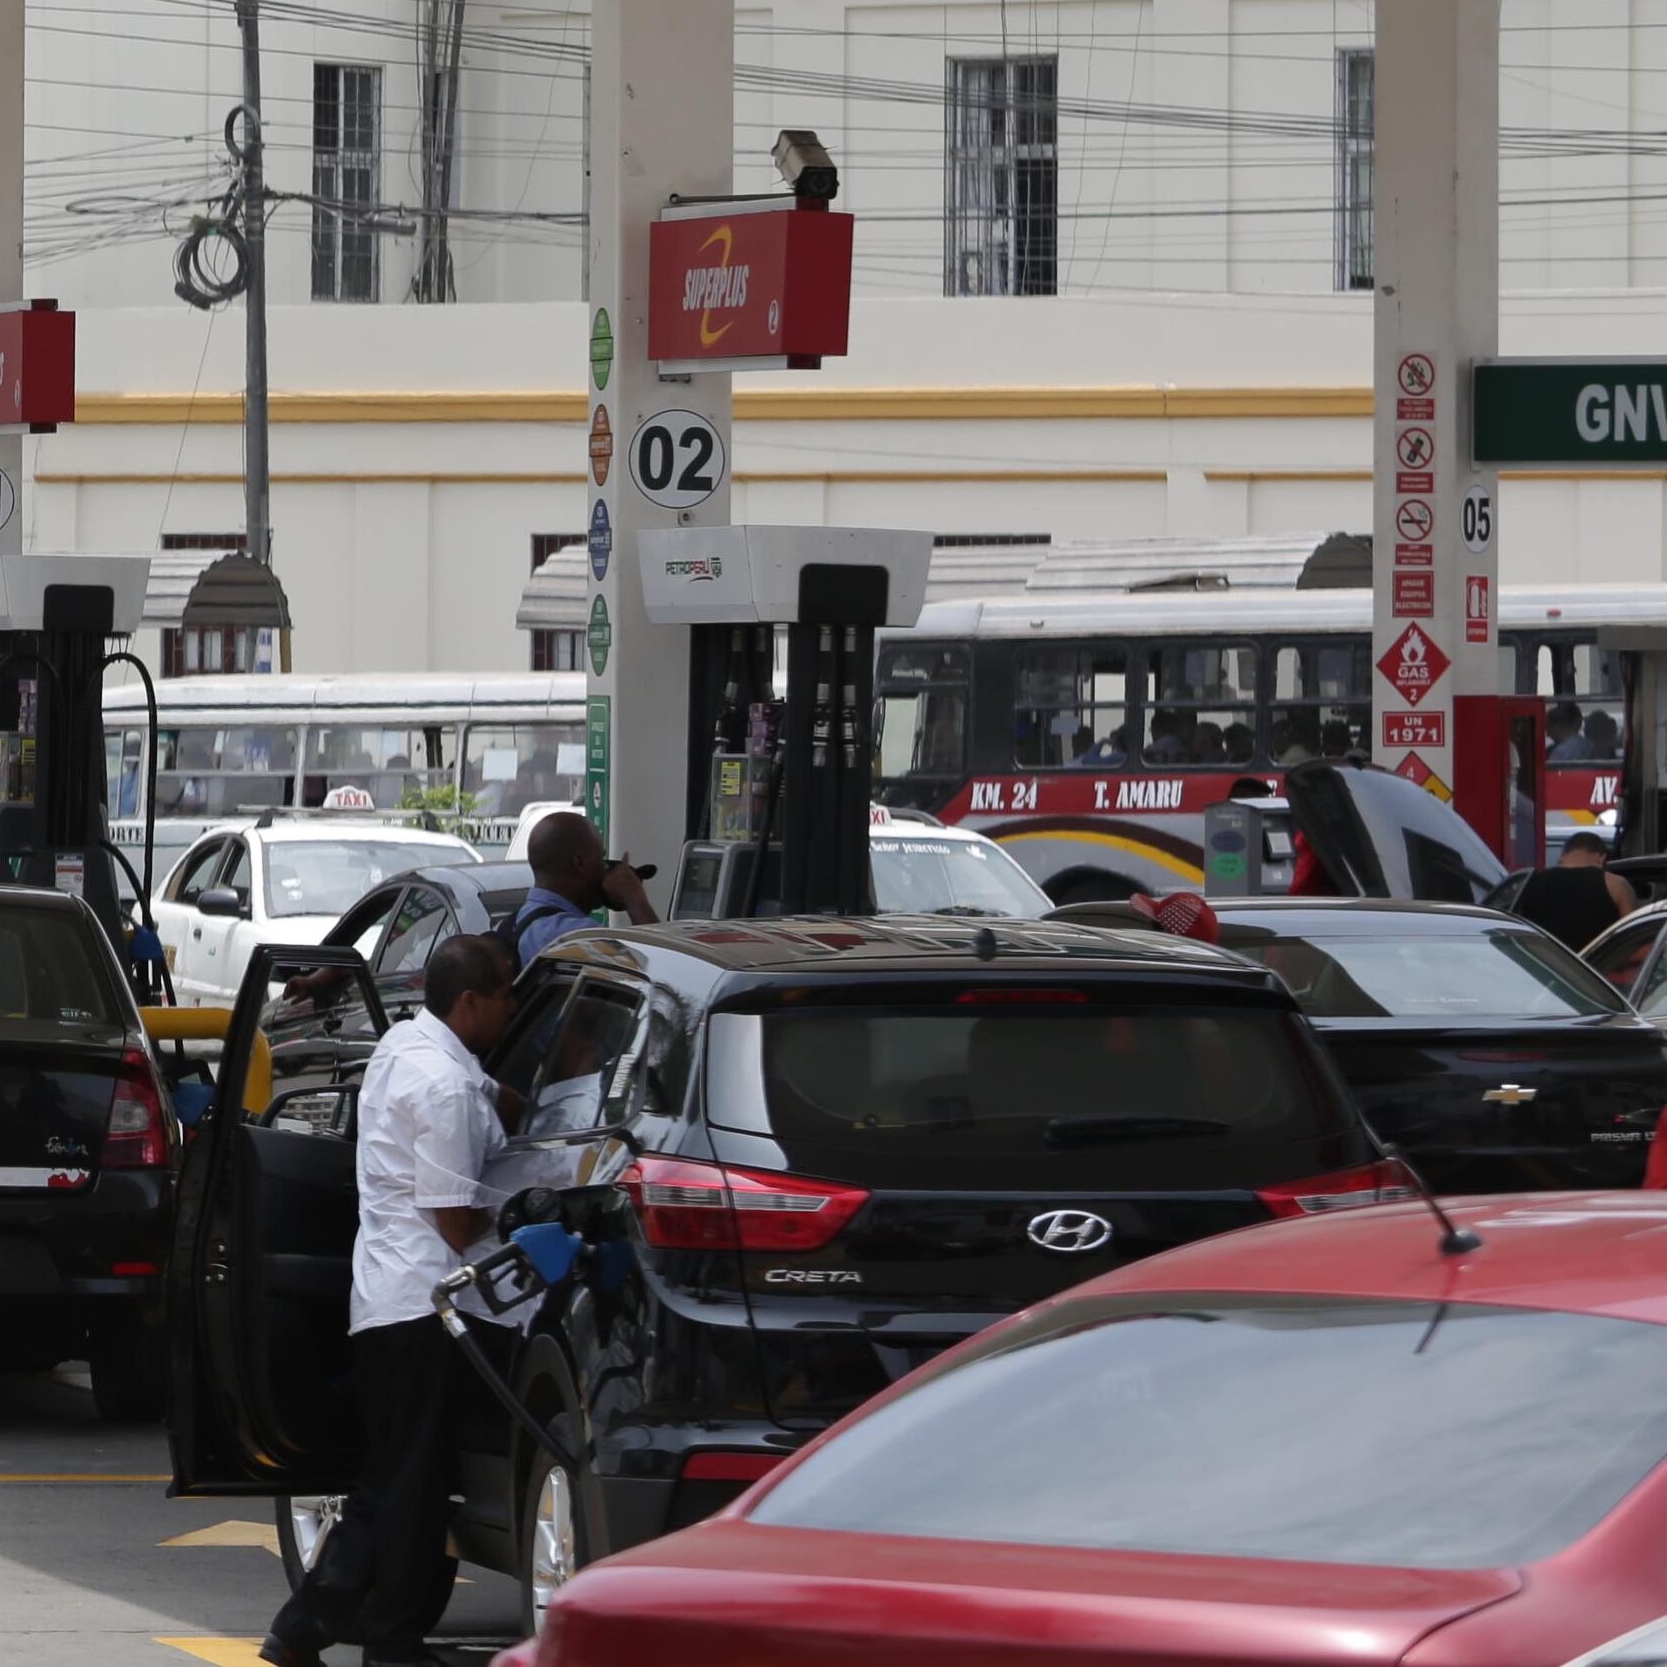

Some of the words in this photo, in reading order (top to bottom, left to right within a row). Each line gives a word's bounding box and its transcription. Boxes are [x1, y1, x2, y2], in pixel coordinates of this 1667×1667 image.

[682, 264, 750, 311] SUPERPLUS
[638, 425, 714, 493] 02
[1463, 497, 1491, 542] 05
[1398, 666, 1429, 679] GAS
[1410, 689, 1417, 700] 2
[1404, 716, 1422, 726] UN
[1389, 728, 1439, 742] 1971
[1406, 766, 1415, 779] 4
[334, 792, 368, 806] TAXI
[970, 782, 1005, 810] KM.
[1011, 777, 1038, 810] 24
[1094, 781, 1110, 809] T.
[1116, 780, 1184, 809] AMARU
[871, 811, 886, 825] XI
[764, 1269, 863, 1283] CRETA
